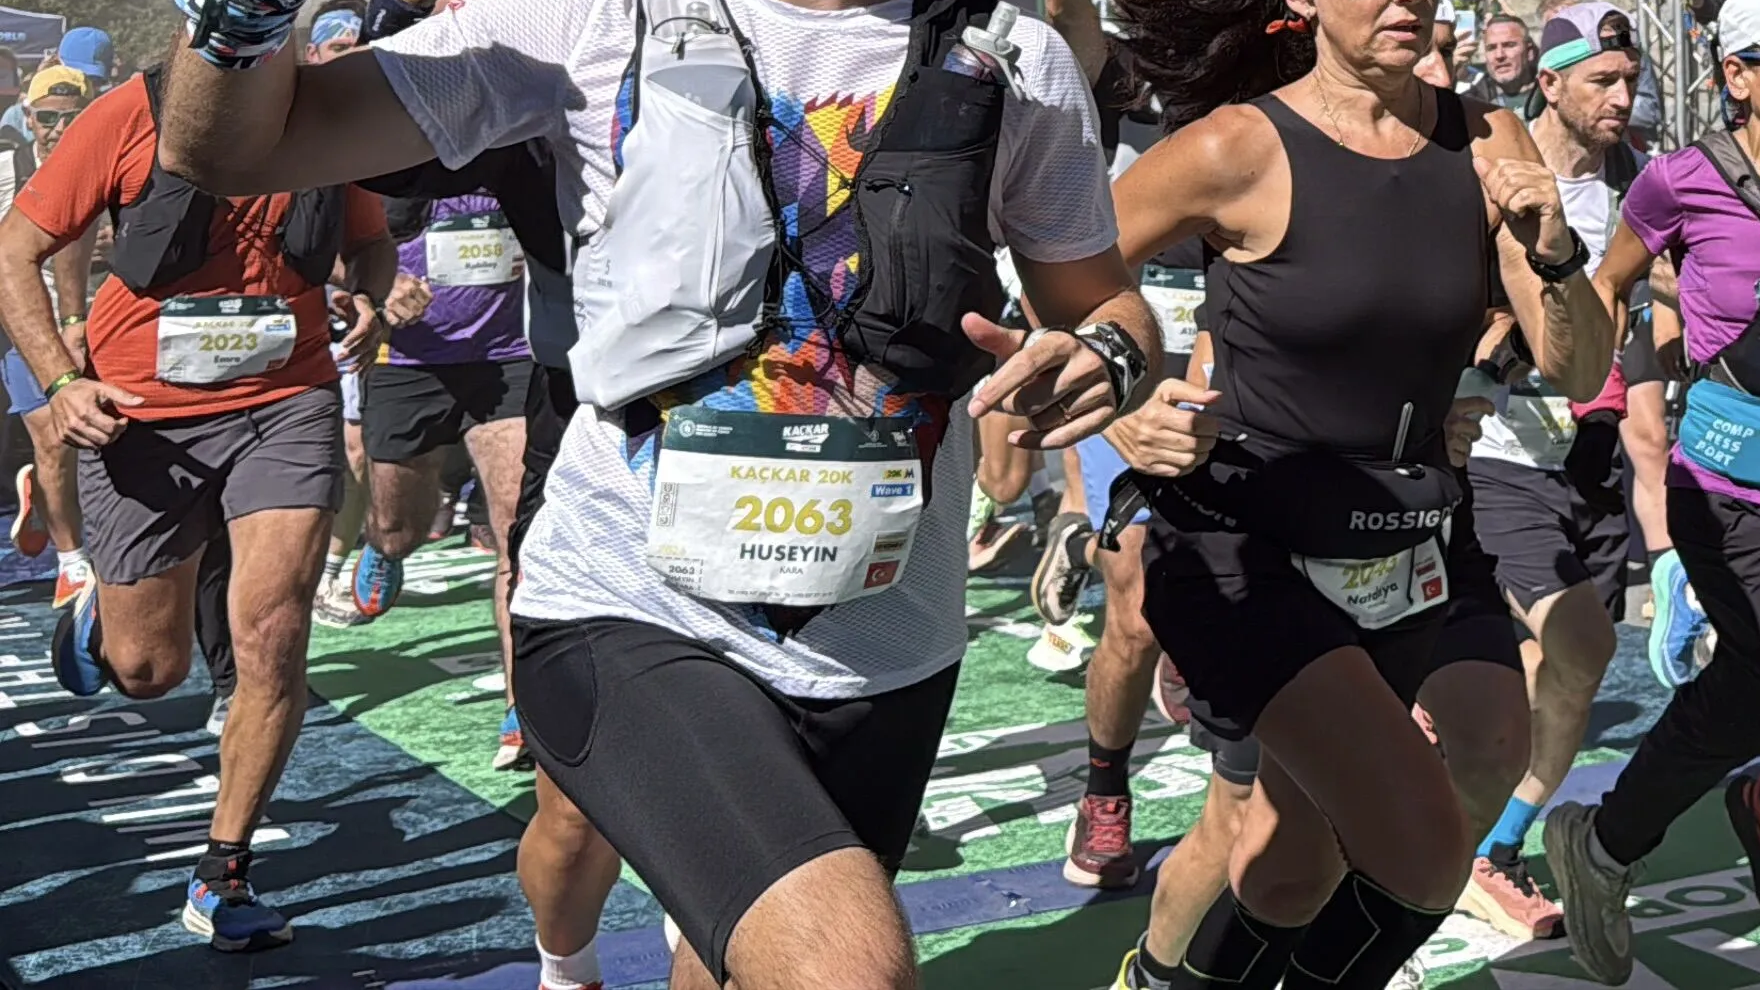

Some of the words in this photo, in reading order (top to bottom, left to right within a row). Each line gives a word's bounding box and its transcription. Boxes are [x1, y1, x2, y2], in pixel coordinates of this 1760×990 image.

[199, 332, 258, 352] 2023
[1712, 418, 1755, 439] COMP
[1705, 429, 1742, 453] RESS
[1694, 439, 1735, 467] PORT
[730, 465, 811, 486] KAÇKAR
[818, 469, 854, 484] 20K
[874, 486, 900, 497] Wave
[905, 484, 913, 496] 1
[732, 494, 853, 537] 2063
[739, 543, 839, 562] HUSEYIN
[668, 565, 695, 575] 2063
[779, 565, 804, 575] KARA
